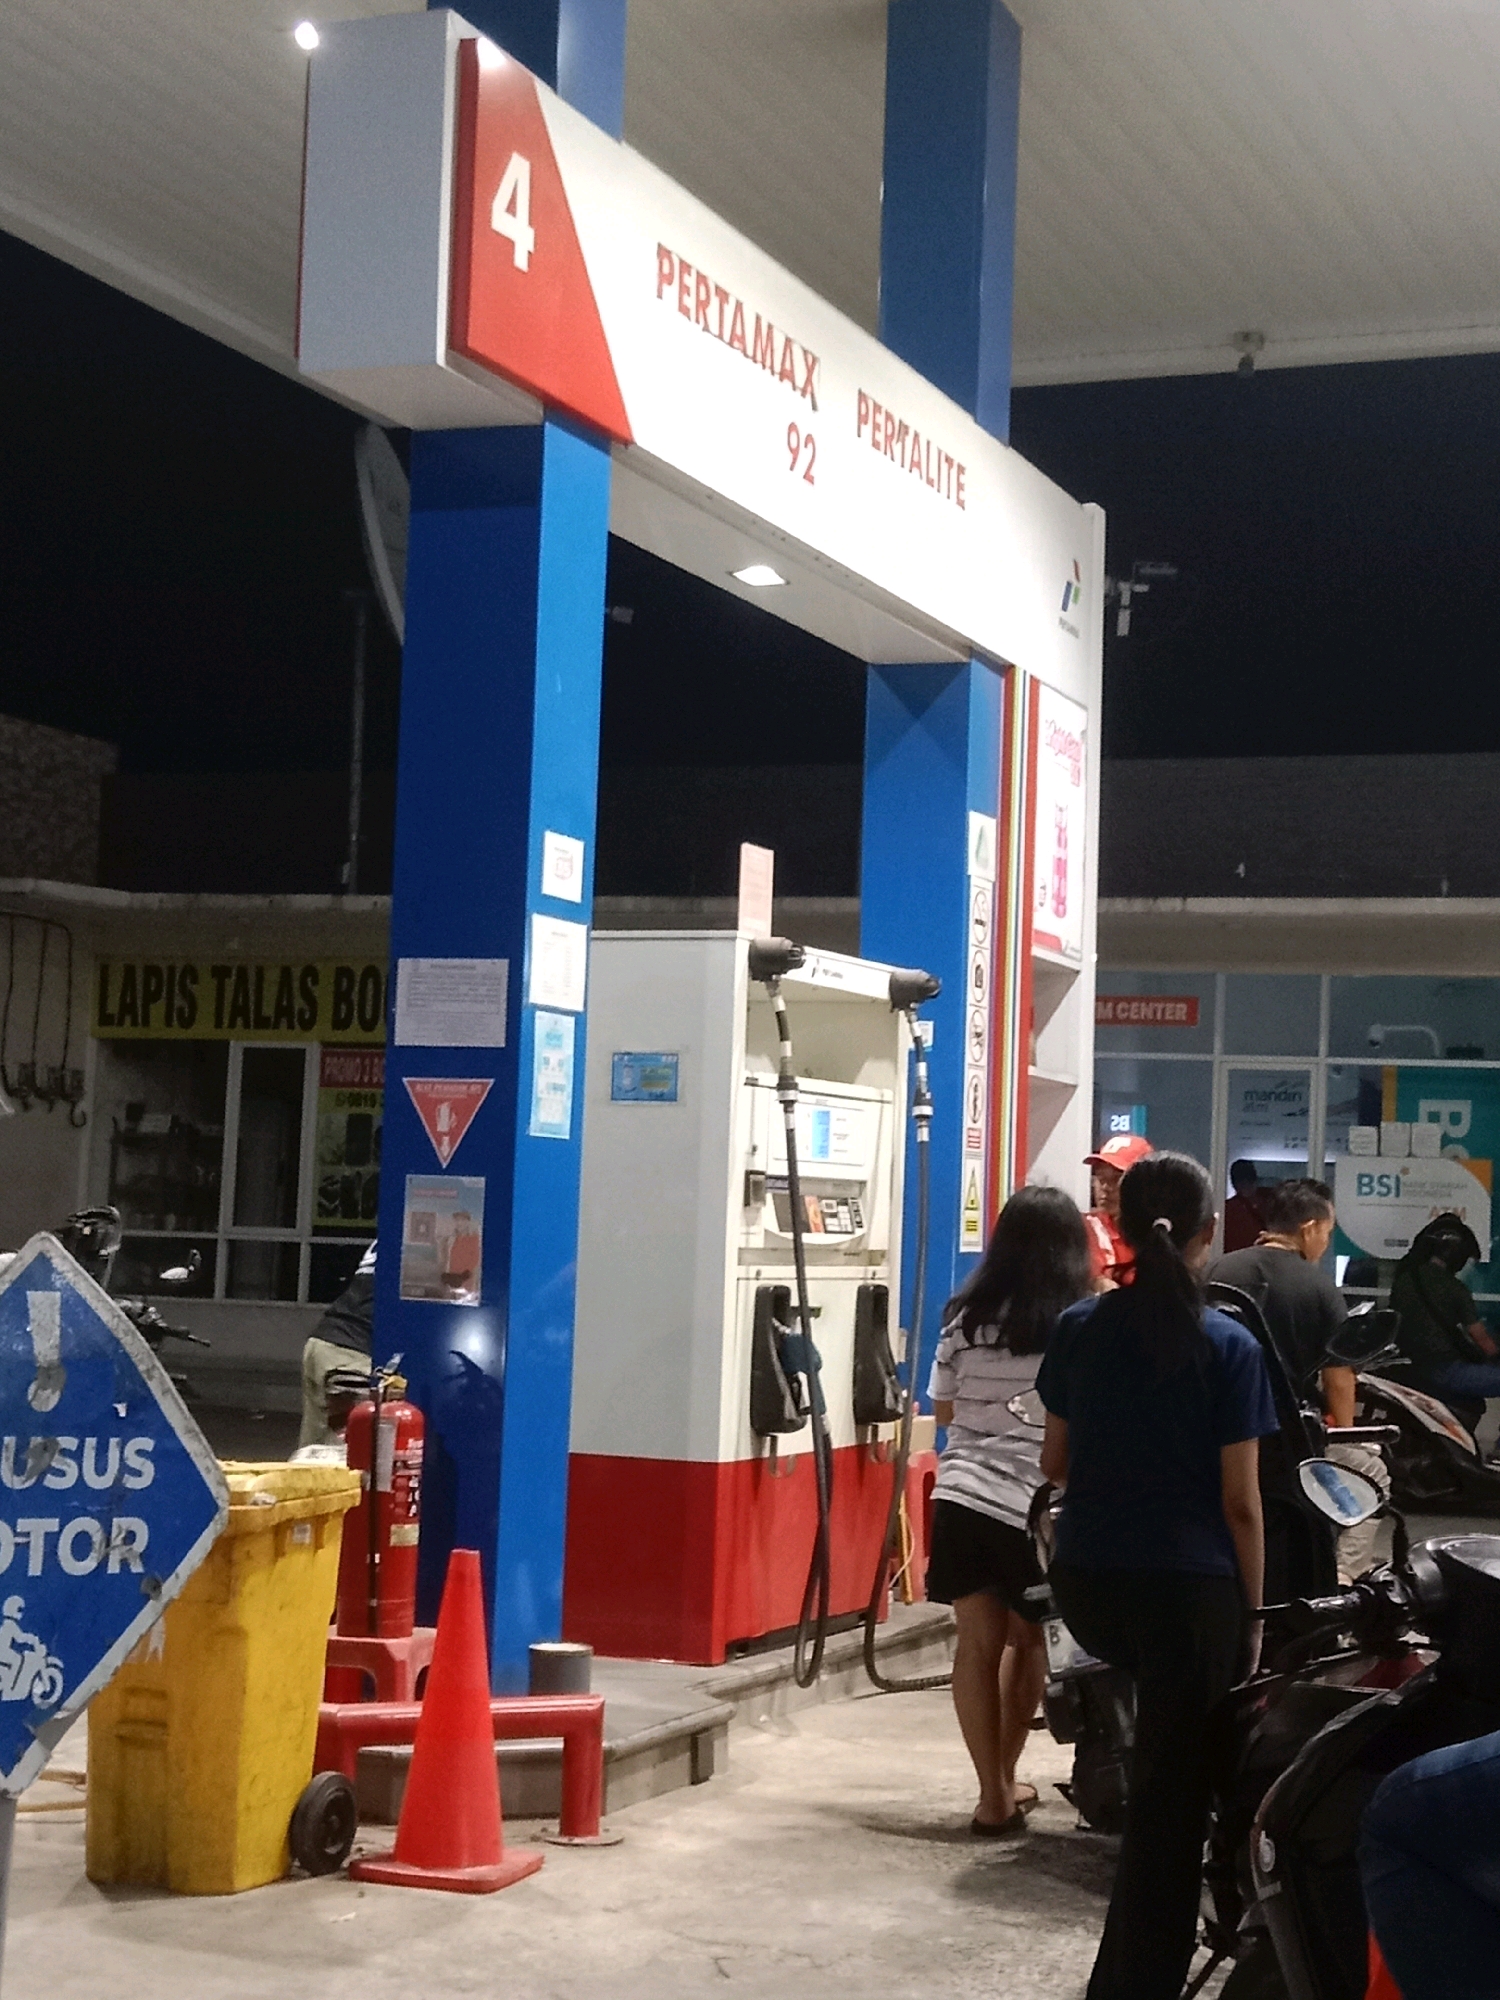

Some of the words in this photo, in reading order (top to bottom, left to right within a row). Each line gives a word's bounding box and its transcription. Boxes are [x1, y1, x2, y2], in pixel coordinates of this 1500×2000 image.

[491, 151, 534, 272] 4
[656, 242, 820, 412] PERTAMAX
[786, 422, 817, 486] 92
[857, 388, 966, 511] PERTALITE
[98, 963, 199, 1030] LAPIS
[210, 964, 320, 1031] TALAS
[331, 965, 388, 1032] BO
[1115, 1002, 1188, 1020] CENTER
[1356, 1173, 1401, 1198] BSI
